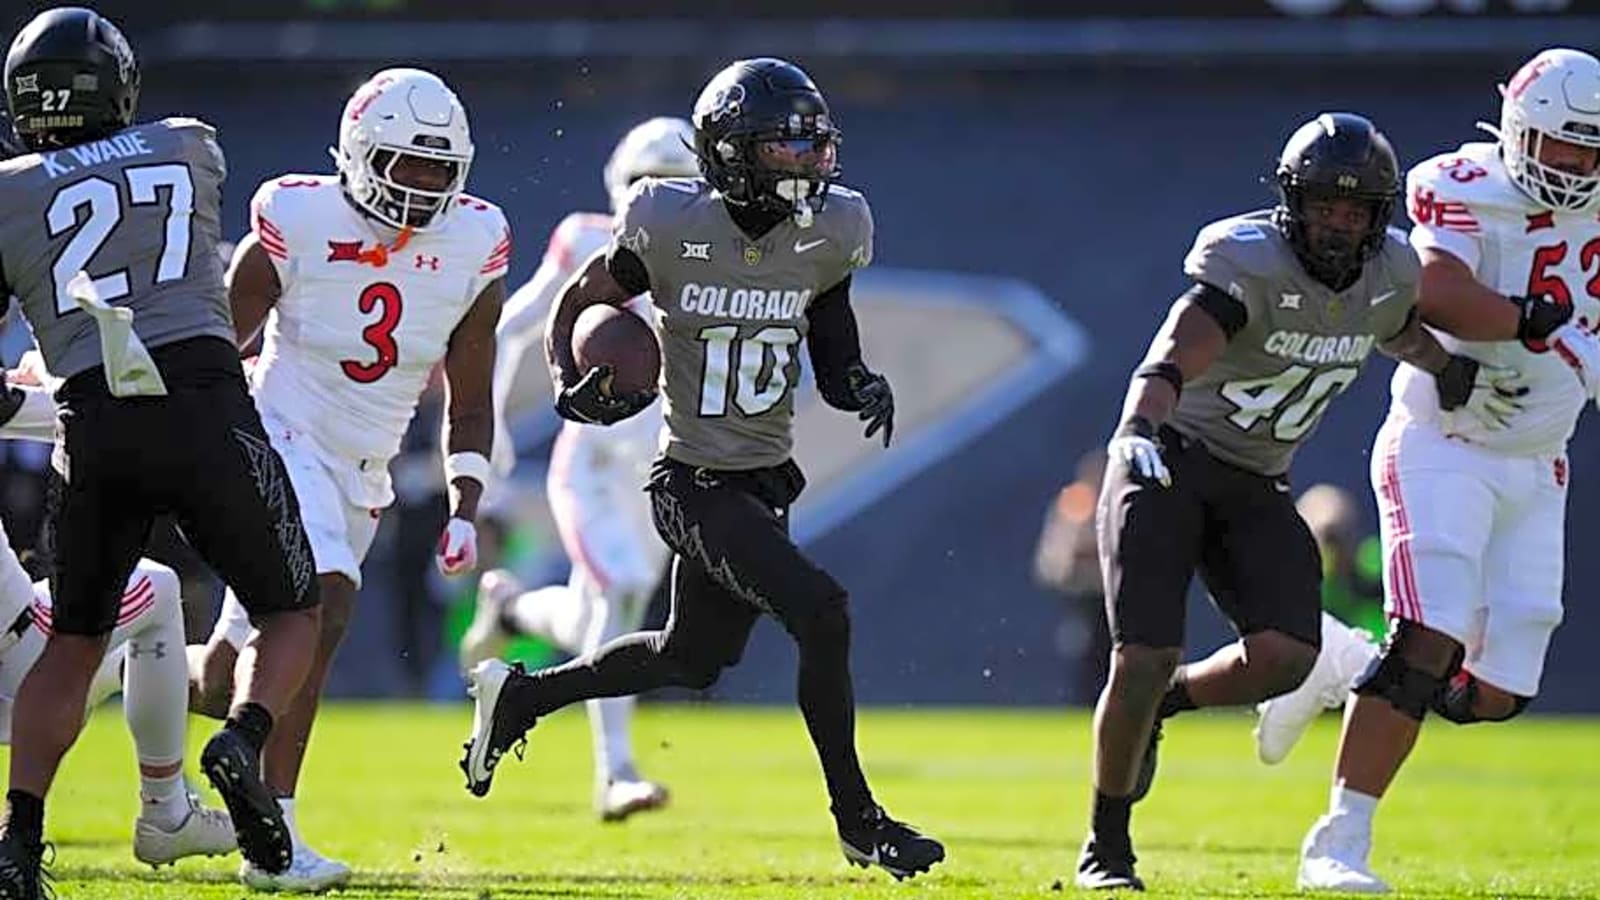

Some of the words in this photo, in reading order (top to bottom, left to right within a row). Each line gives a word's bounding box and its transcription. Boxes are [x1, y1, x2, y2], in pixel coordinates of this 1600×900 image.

[41, 89, 71, 111] 27
[48, 163, 194, 317] 27
[339, 282, 402, 383] 3
[680, 282, 812, 321] COLORADO
[695, 323, 802, 418] 10
[1219, 365, 1359, 443] 40
